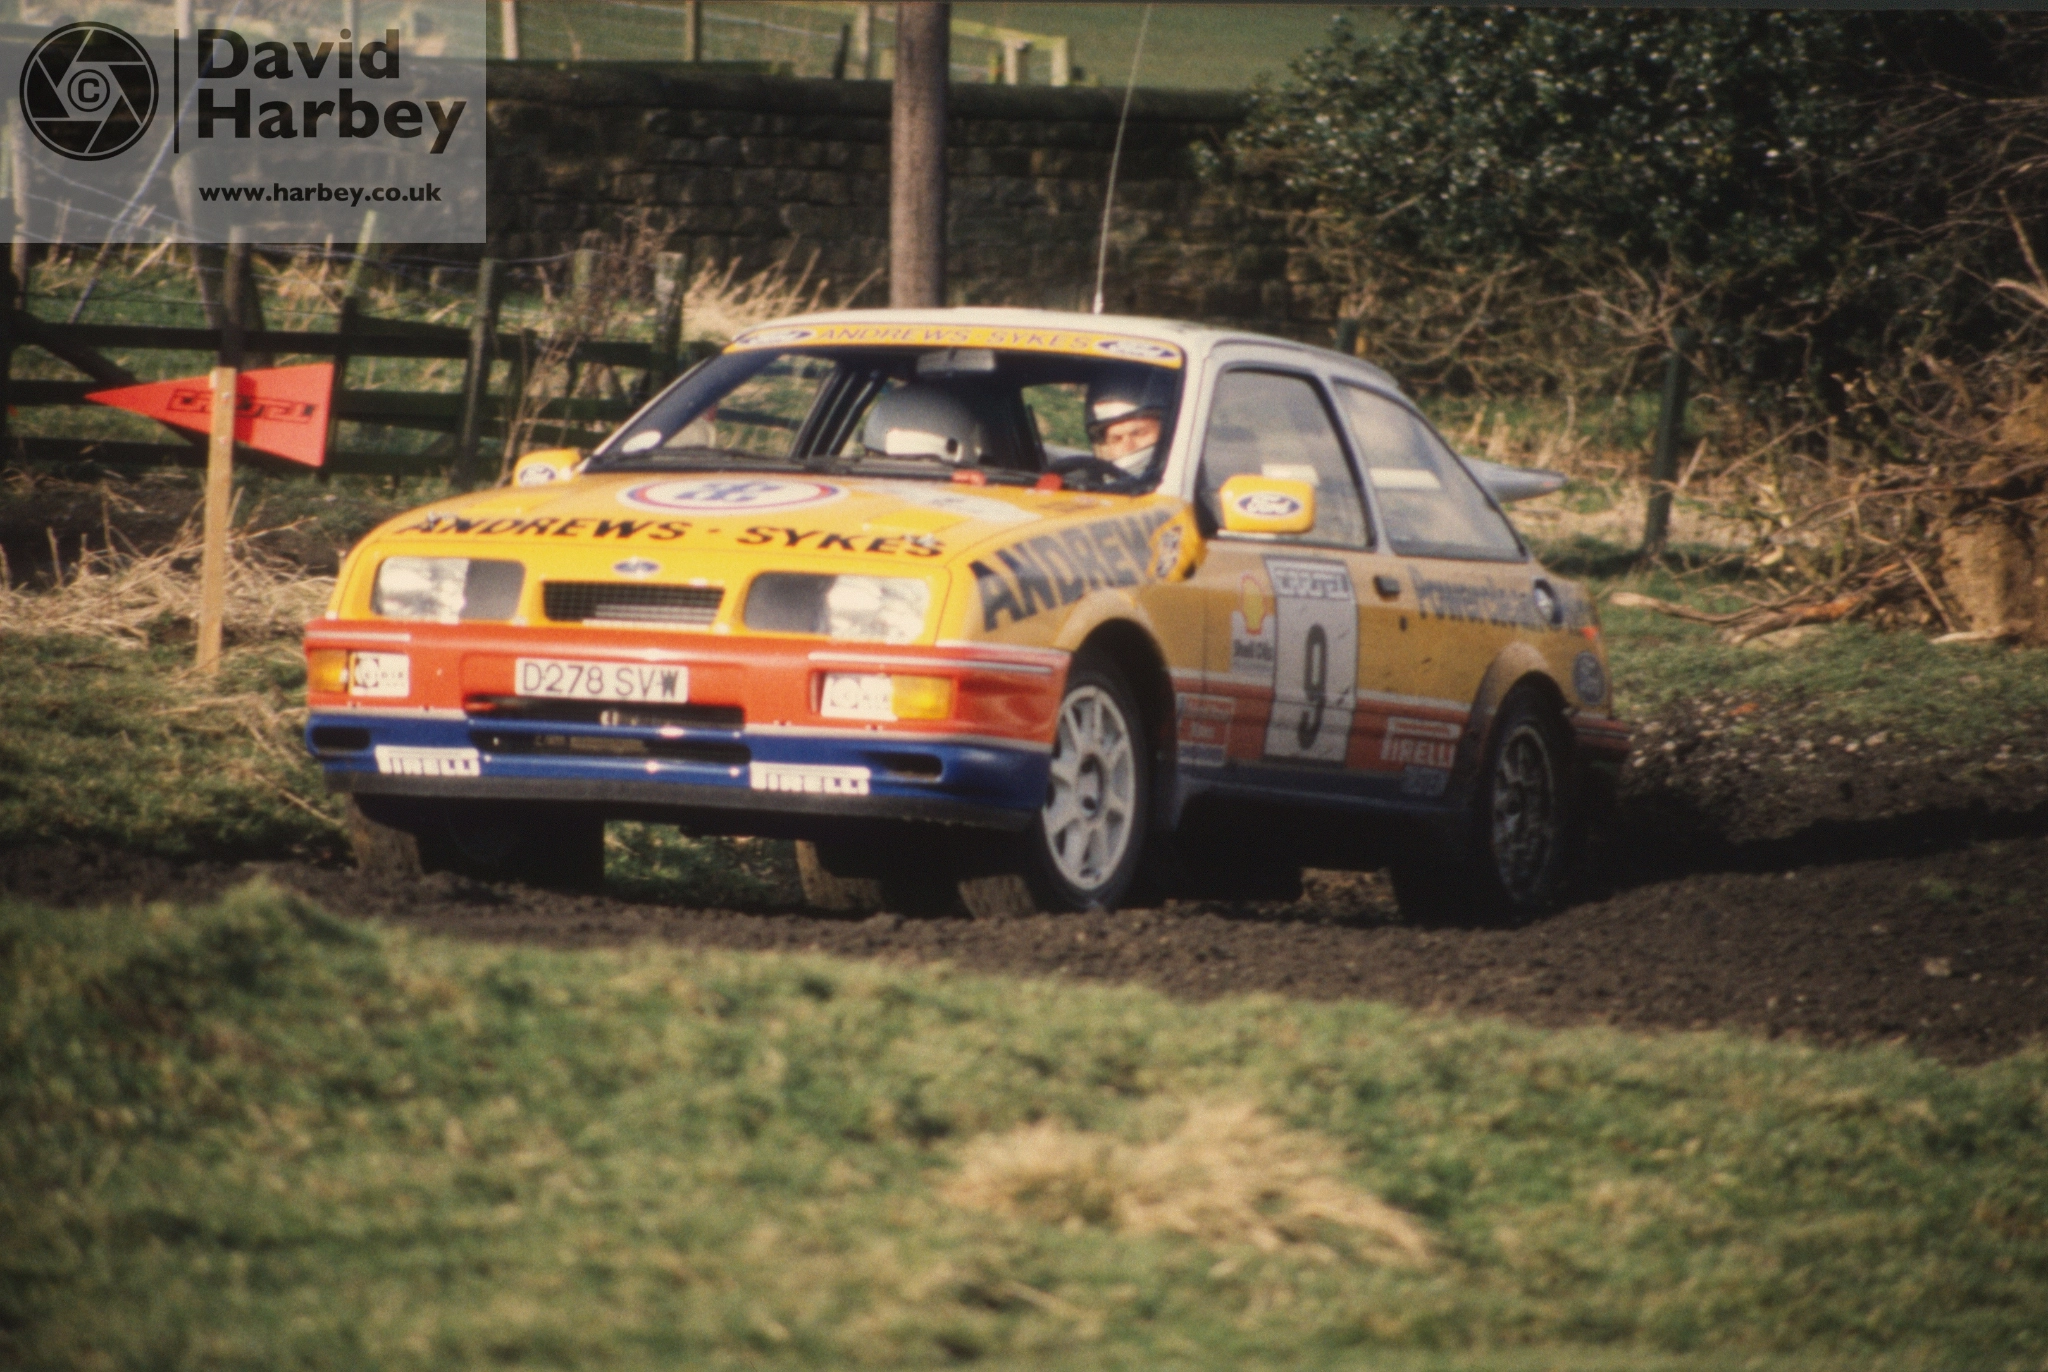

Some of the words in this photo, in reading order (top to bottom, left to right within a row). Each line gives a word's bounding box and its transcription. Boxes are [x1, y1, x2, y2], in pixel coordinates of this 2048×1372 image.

[818, 327, 969, 343] ANDREWS
[989, 330, 1091, 350] SYKES
[393, 517, 694, 541] ANDREWS
[735, 526, 946, 558] SYKES
[968, 509, 1174, 633] ANDREW
[522, 662, 604, 695] D278
[615, 667, 679, 699] SVW
[1297, 622, 1328, 751] 9
